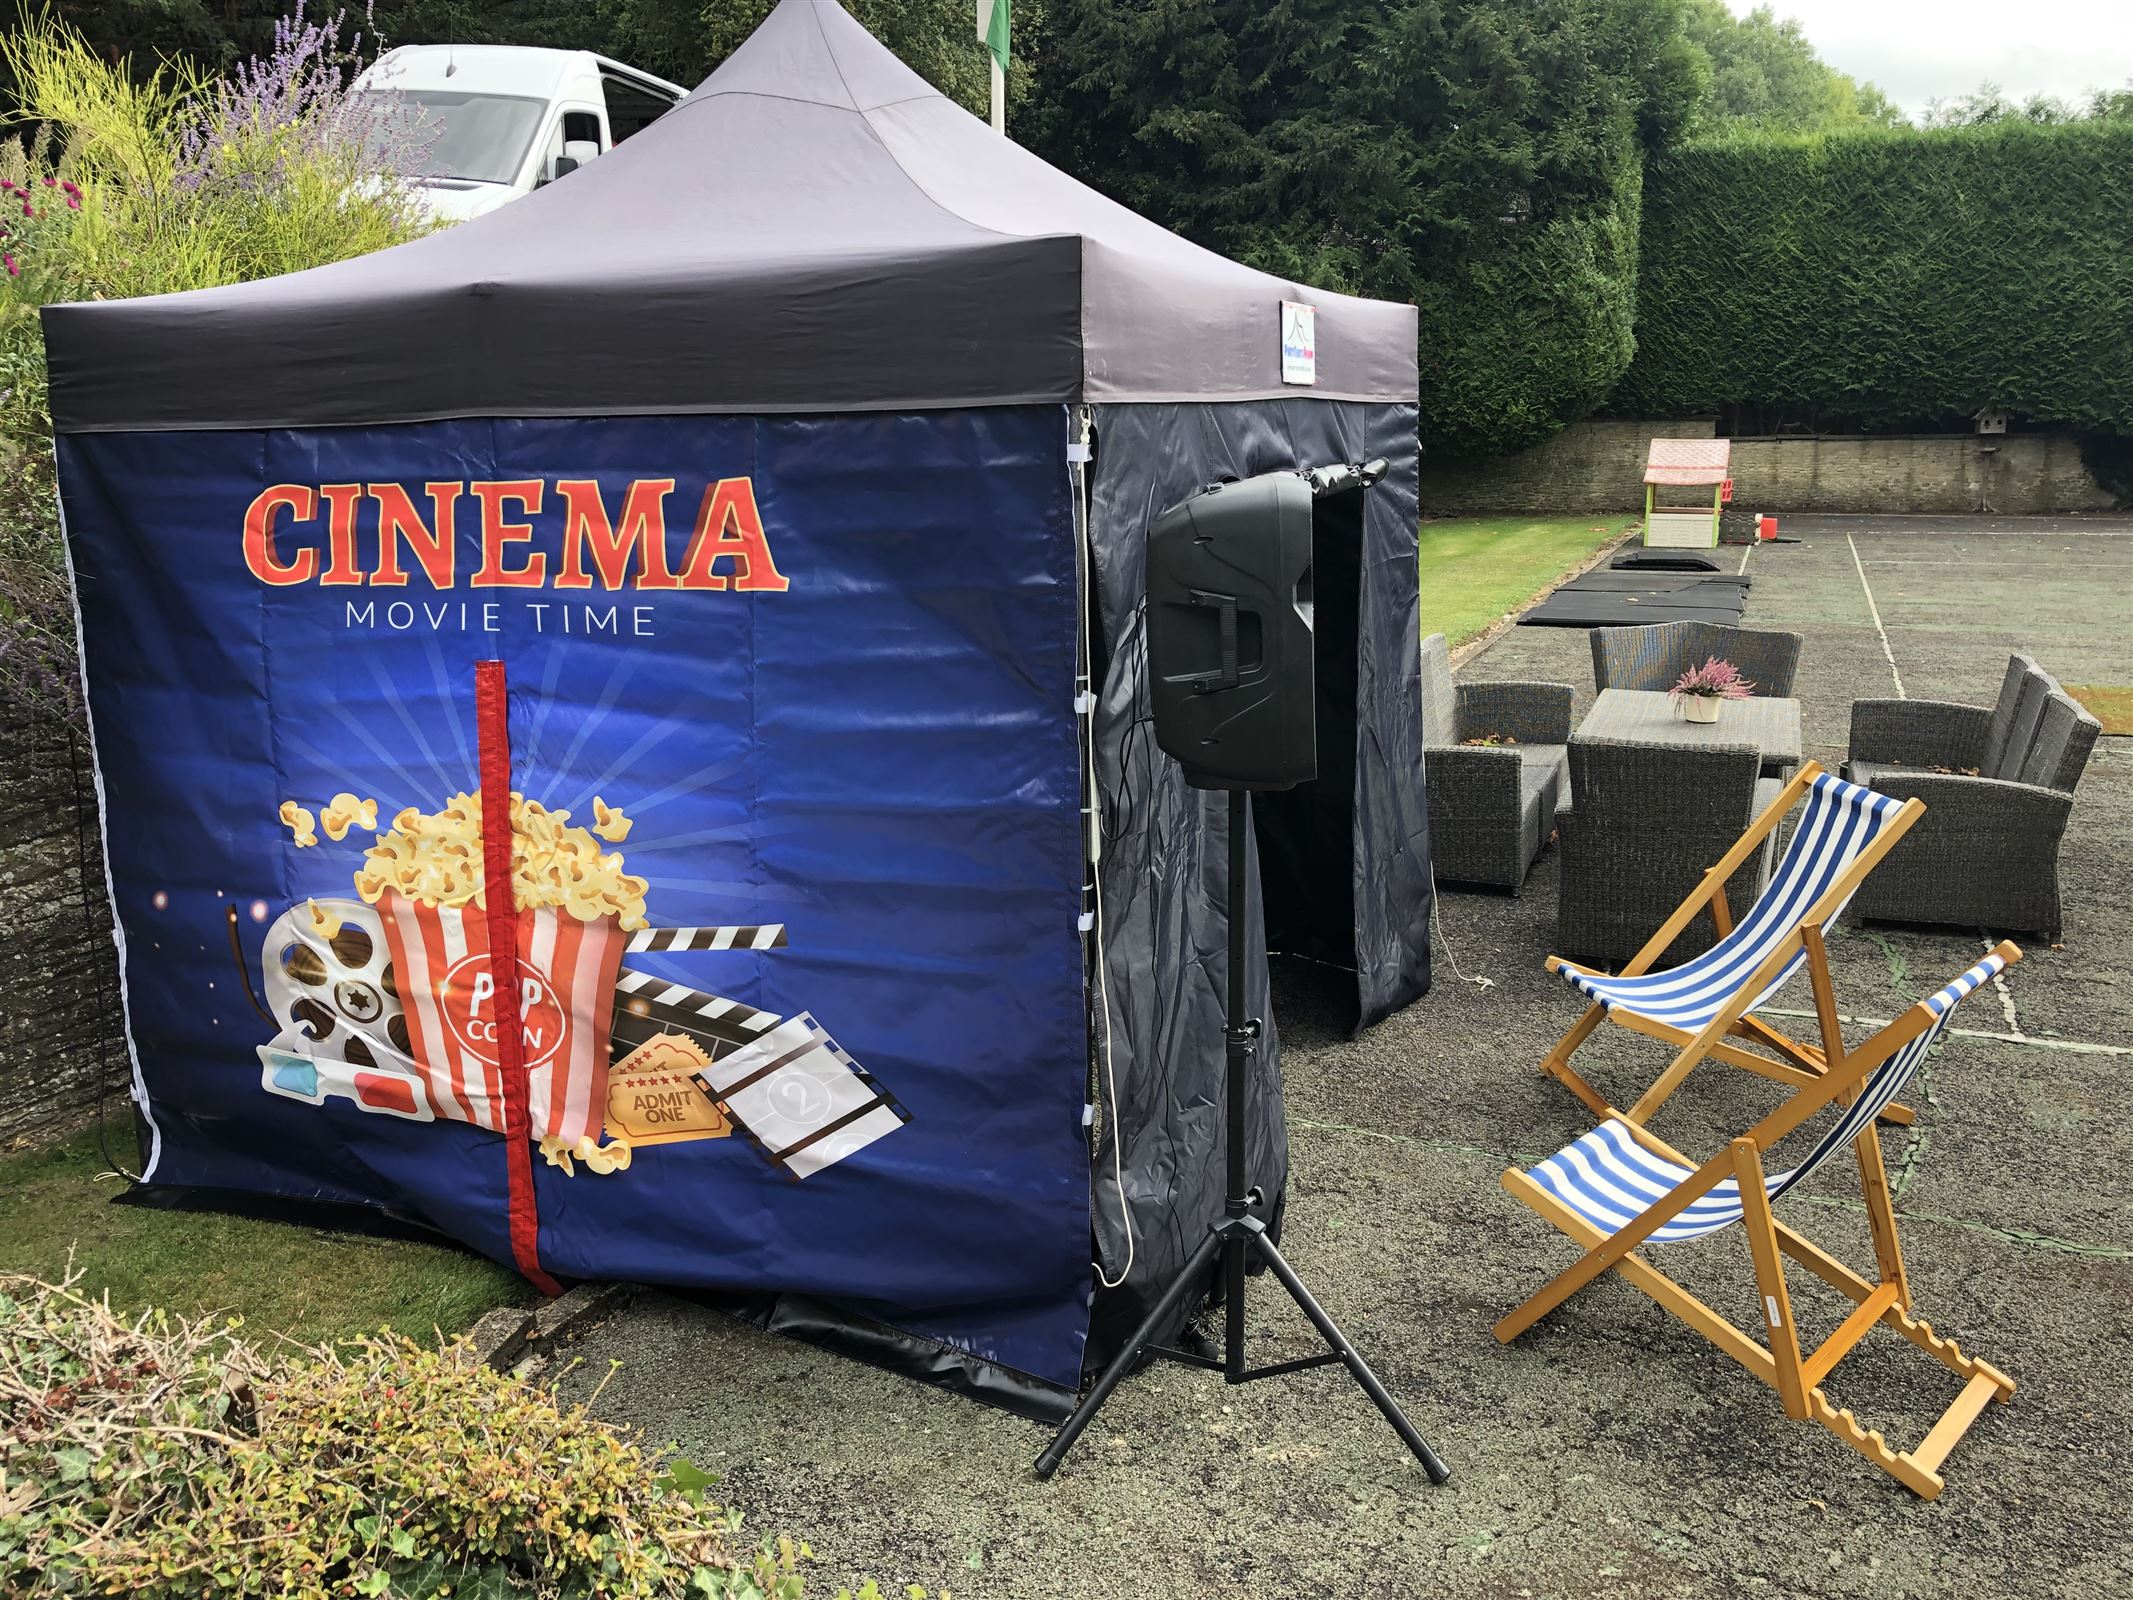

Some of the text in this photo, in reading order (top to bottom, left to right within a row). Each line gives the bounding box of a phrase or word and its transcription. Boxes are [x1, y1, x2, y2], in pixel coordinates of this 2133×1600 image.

[242, 476, 790, 592] CINEMA
[346, 601, 655, 637] MOVIE TIME
[470, 972, 542, 1022] PP
[466, 1019, 542, 1048] CON
[633, 1090, 692, 1111] ADMIT
[645, 1106, 686, 1124] ONE
[782, 1081, 822, 1116] 2
